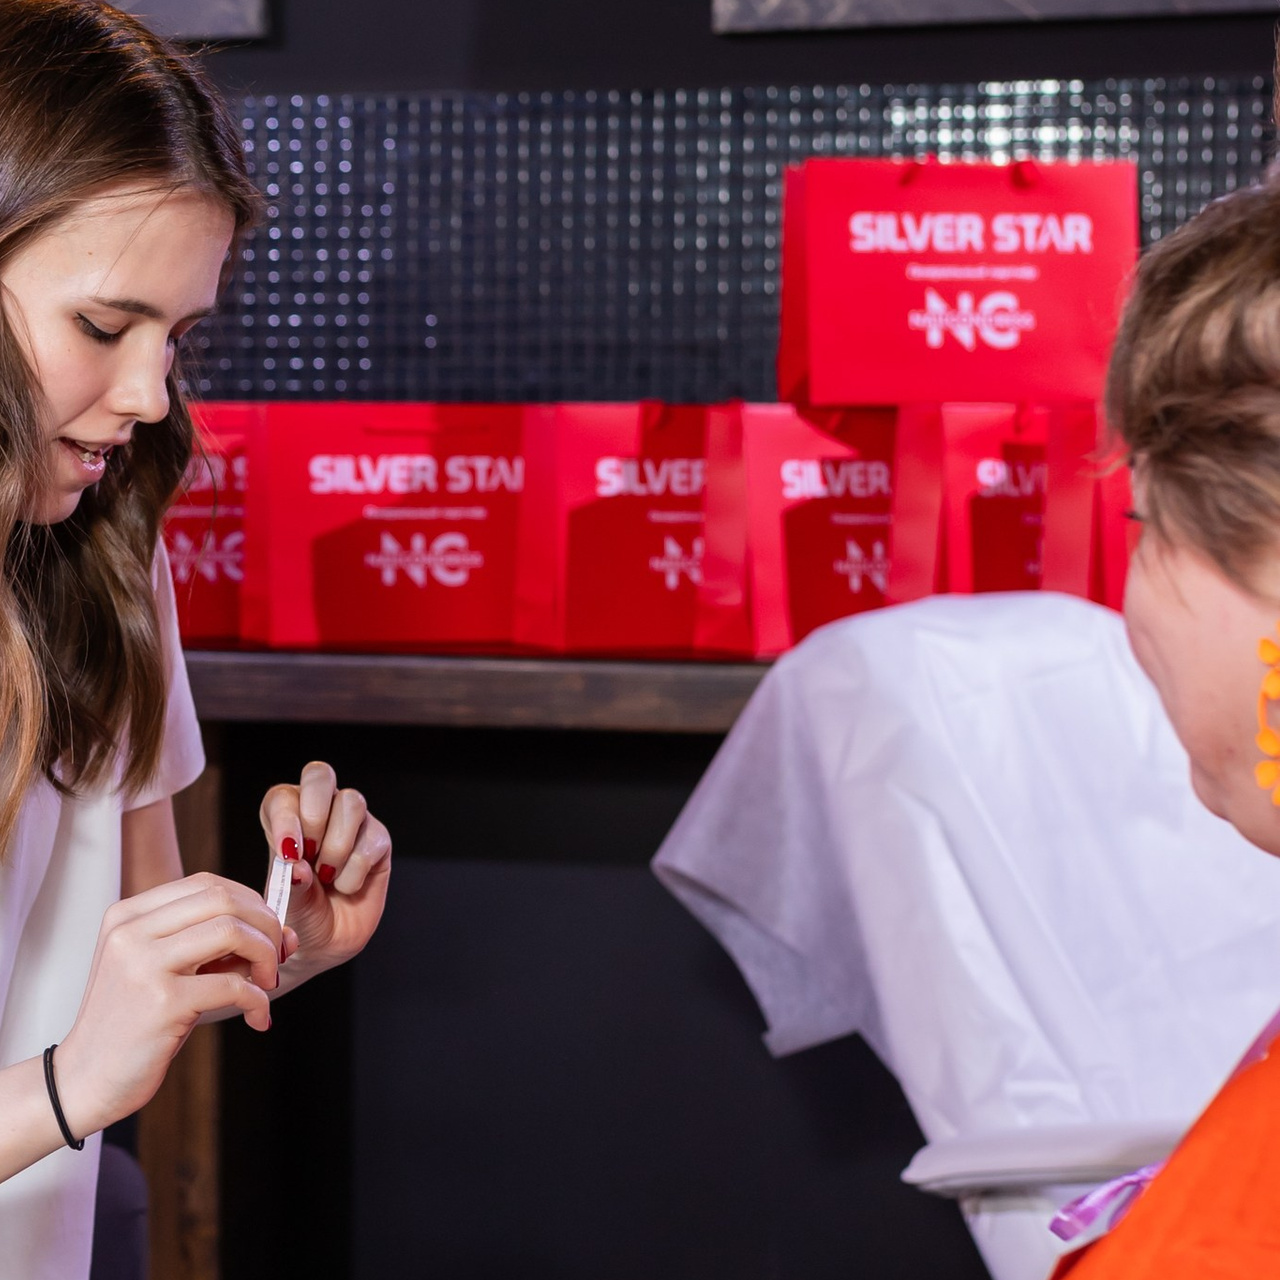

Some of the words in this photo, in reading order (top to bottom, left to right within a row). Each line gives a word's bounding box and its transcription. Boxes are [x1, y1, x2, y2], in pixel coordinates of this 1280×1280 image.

[848, 212, 984, 252] SILVER
[991, 212, 1094, 253] STAR
[308, 453, 437, 494] SILVER
[781, 460, 891, 498] SILVER
